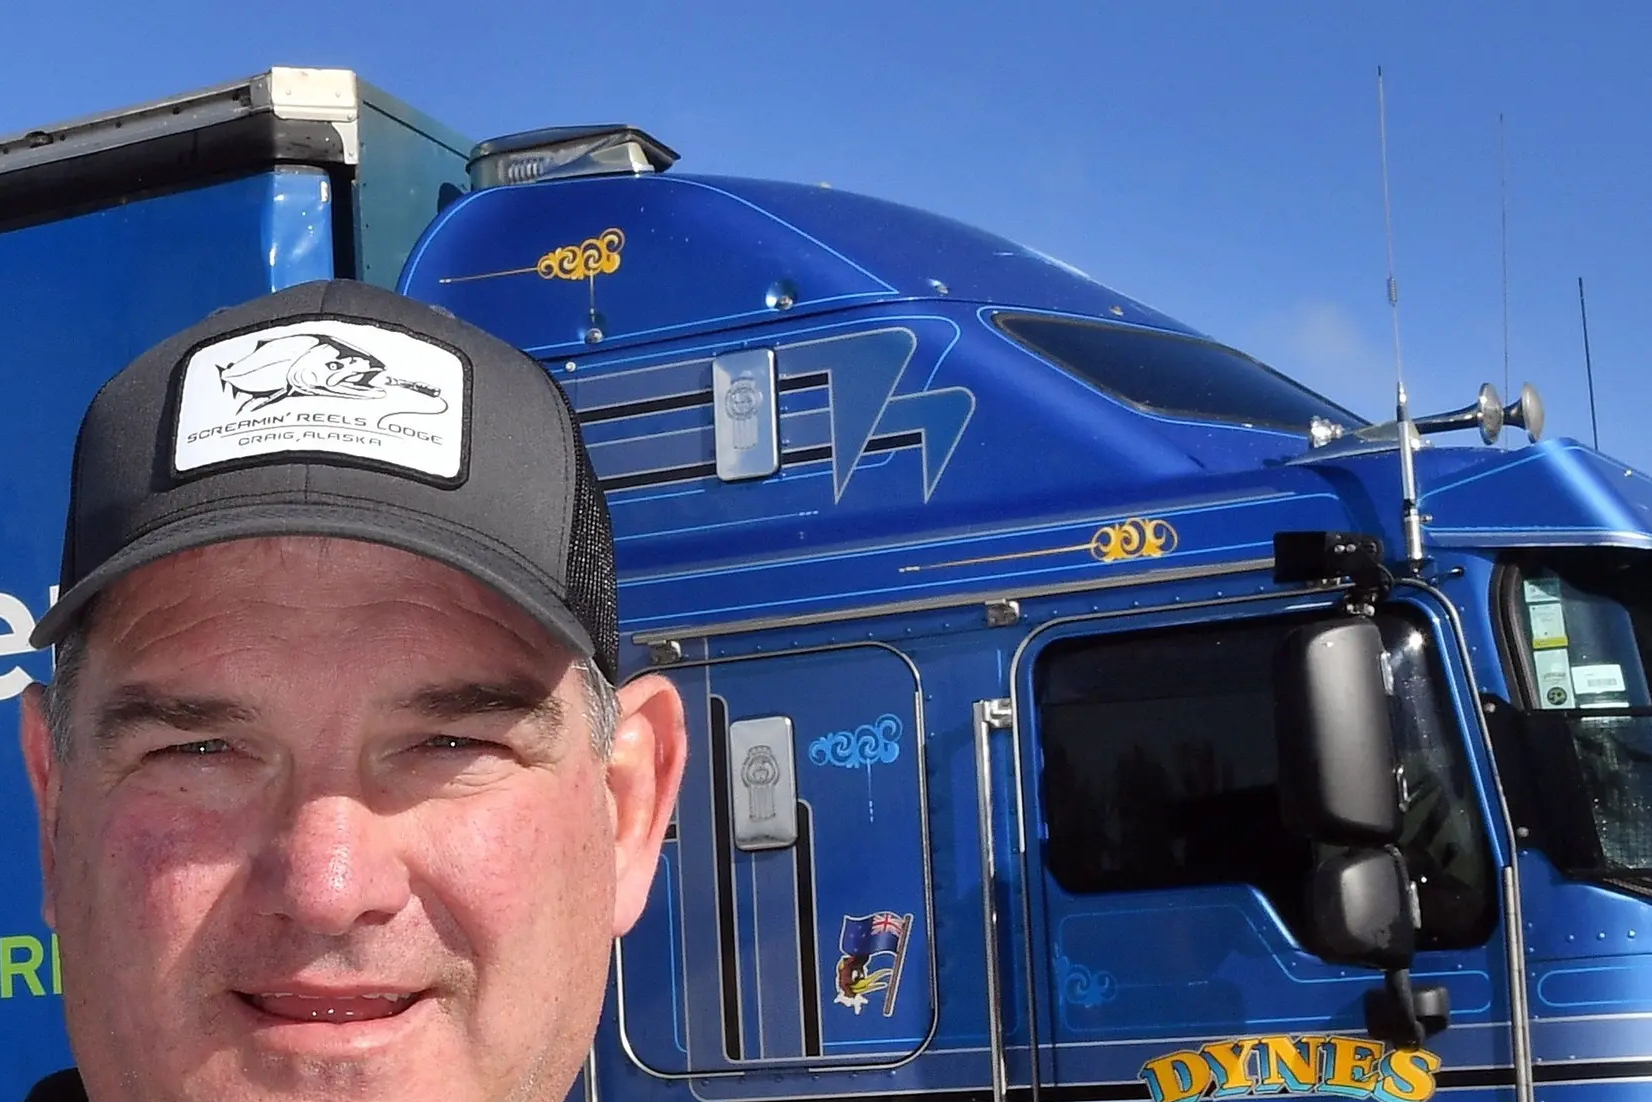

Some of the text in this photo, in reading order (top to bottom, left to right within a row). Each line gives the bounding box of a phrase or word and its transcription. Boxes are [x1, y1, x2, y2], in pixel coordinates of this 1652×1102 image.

[187, 411, 444, 446] SCREAMIN' REELS LODGE
[238, 430, 382, 447] CRAIG, ALASKA
